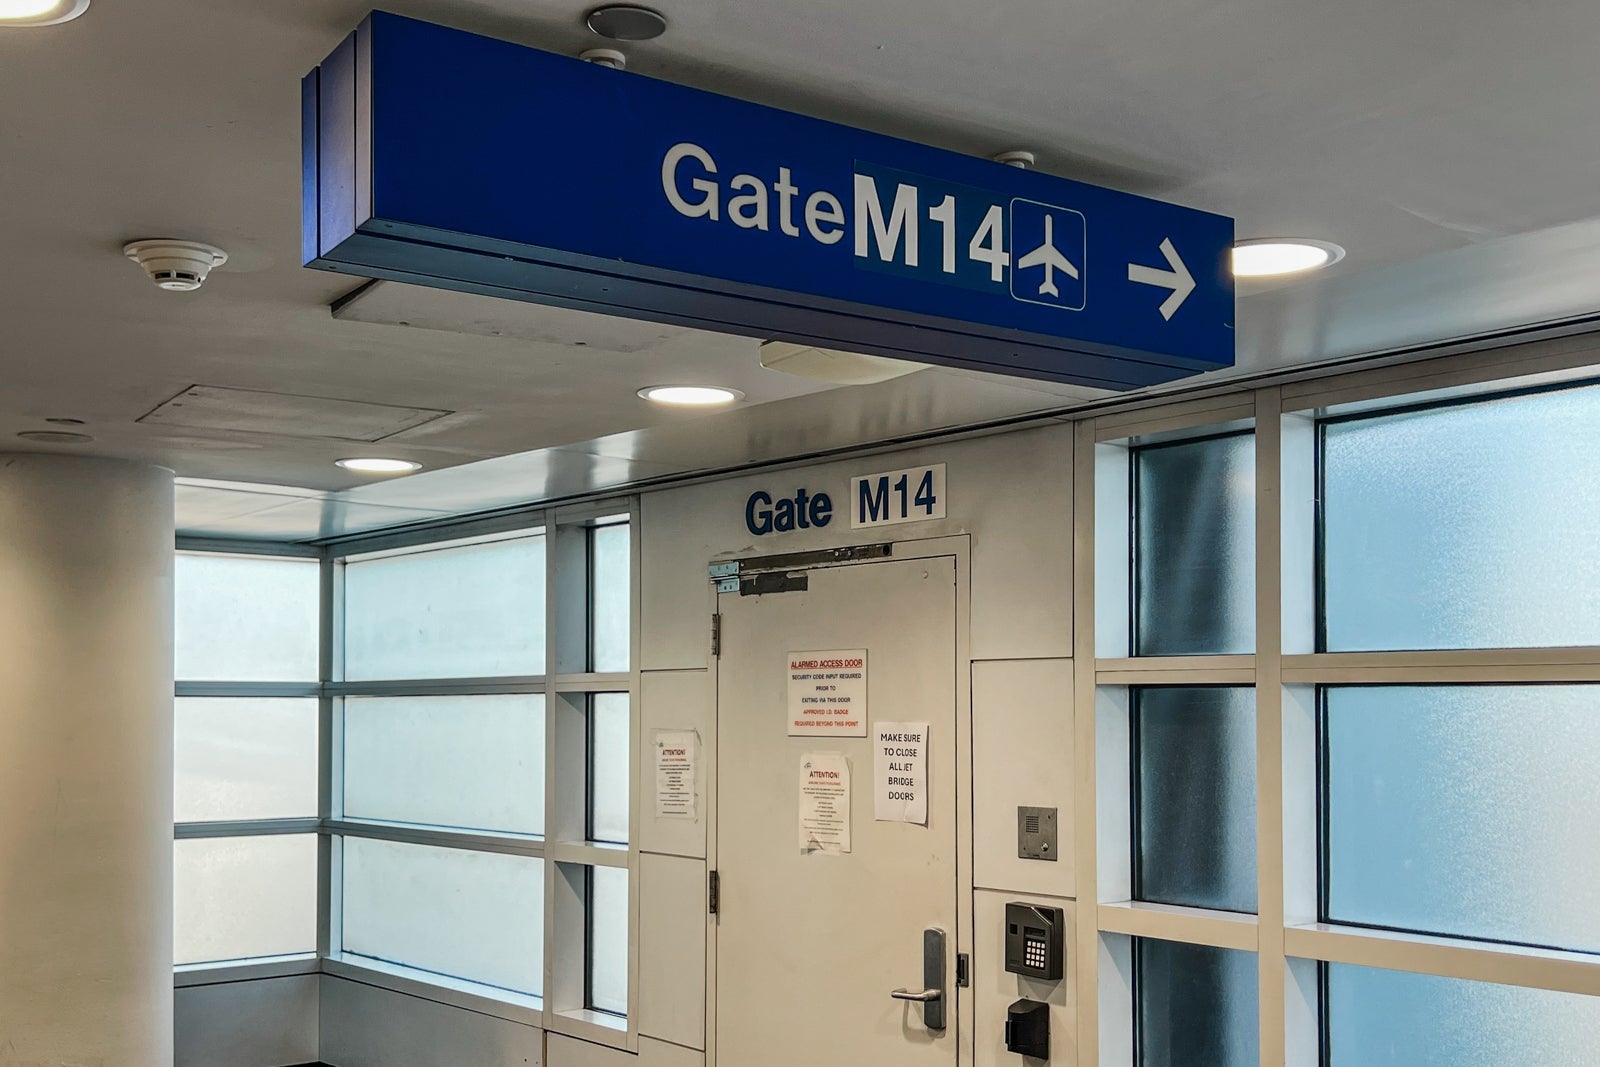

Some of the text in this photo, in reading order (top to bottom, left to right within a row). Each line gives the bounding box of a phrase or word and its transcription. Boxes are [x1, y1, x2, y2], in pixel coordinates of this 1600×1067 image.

[661, 142, 1010, 283] Gate M14
[745, 470, 937, 536] Gate M14
[791, 658, 863, 668] ALARMED ACCESS DOOR
[880, 733, 921, 742] MAKE SURE
[883, 747, 917, 757] TO CLOSE
[889, 762, 913, 771] ALL JET
[809, 770, 840, 779] ATTENTION!
[888, 777, 914, 786] BRIDGE
[888, 791, 914, 801] DOORS
